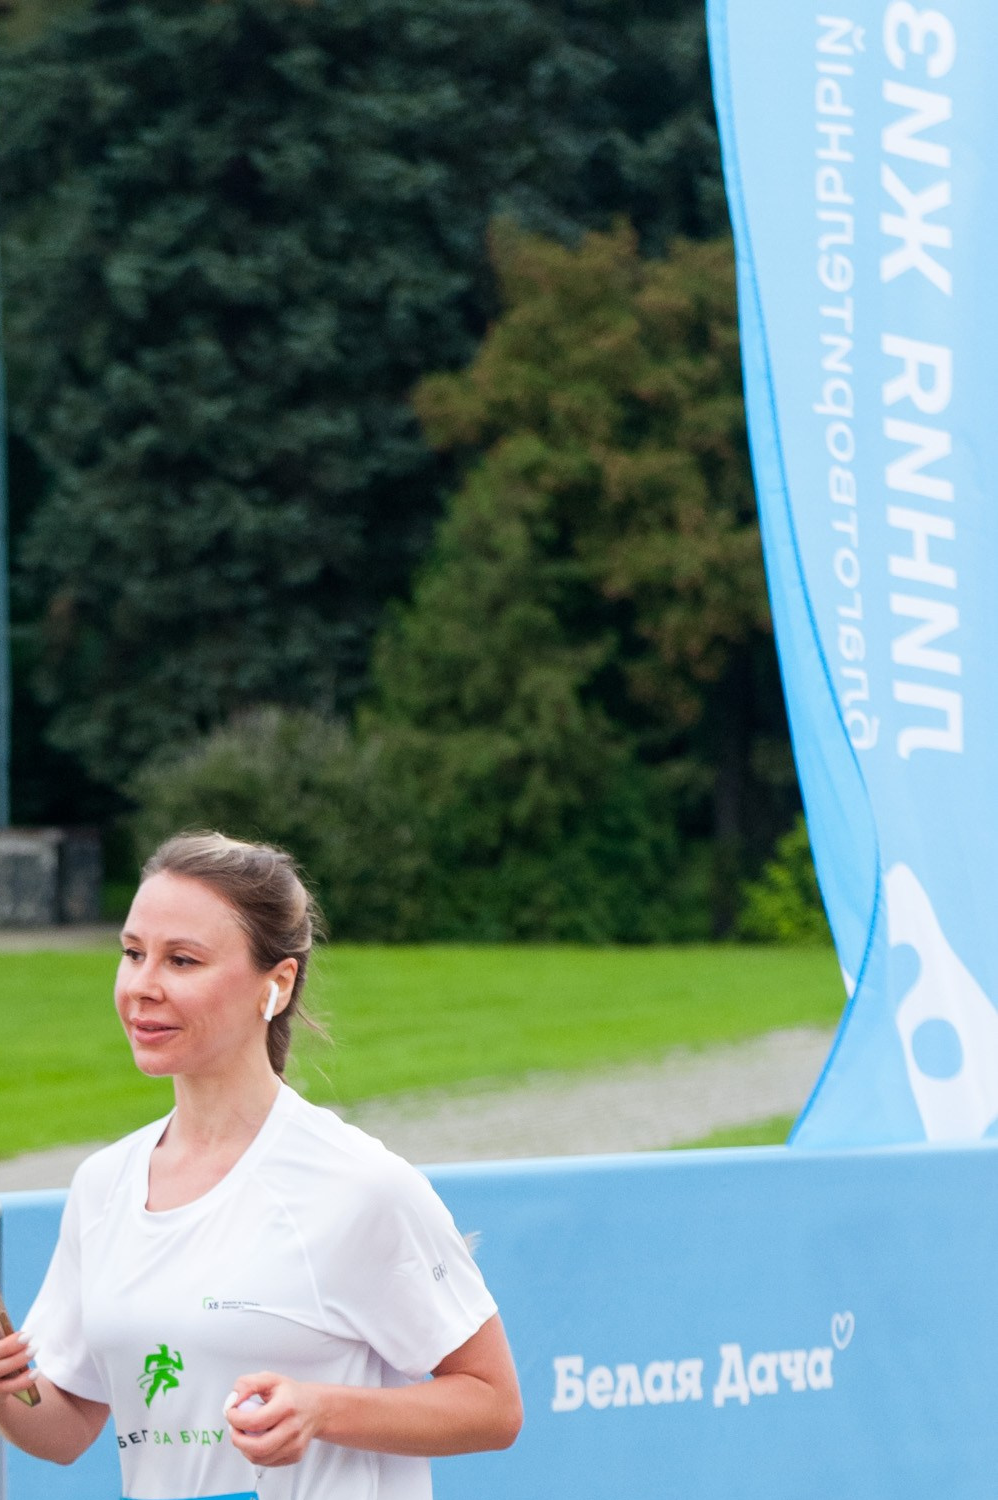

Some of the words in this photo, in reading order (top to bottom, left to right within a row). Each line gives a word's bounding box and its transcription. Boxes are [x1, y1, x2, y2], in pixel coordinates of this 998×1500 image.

[551, 1354, 704, 1413] Белая
[712, 1342, 834, 1409] Дача
[117, 1429, 149, 1449] БЕГ
[153, 1430, 173, 1446] ЗА
[179, 1429, 225, 1446] БУДУ
